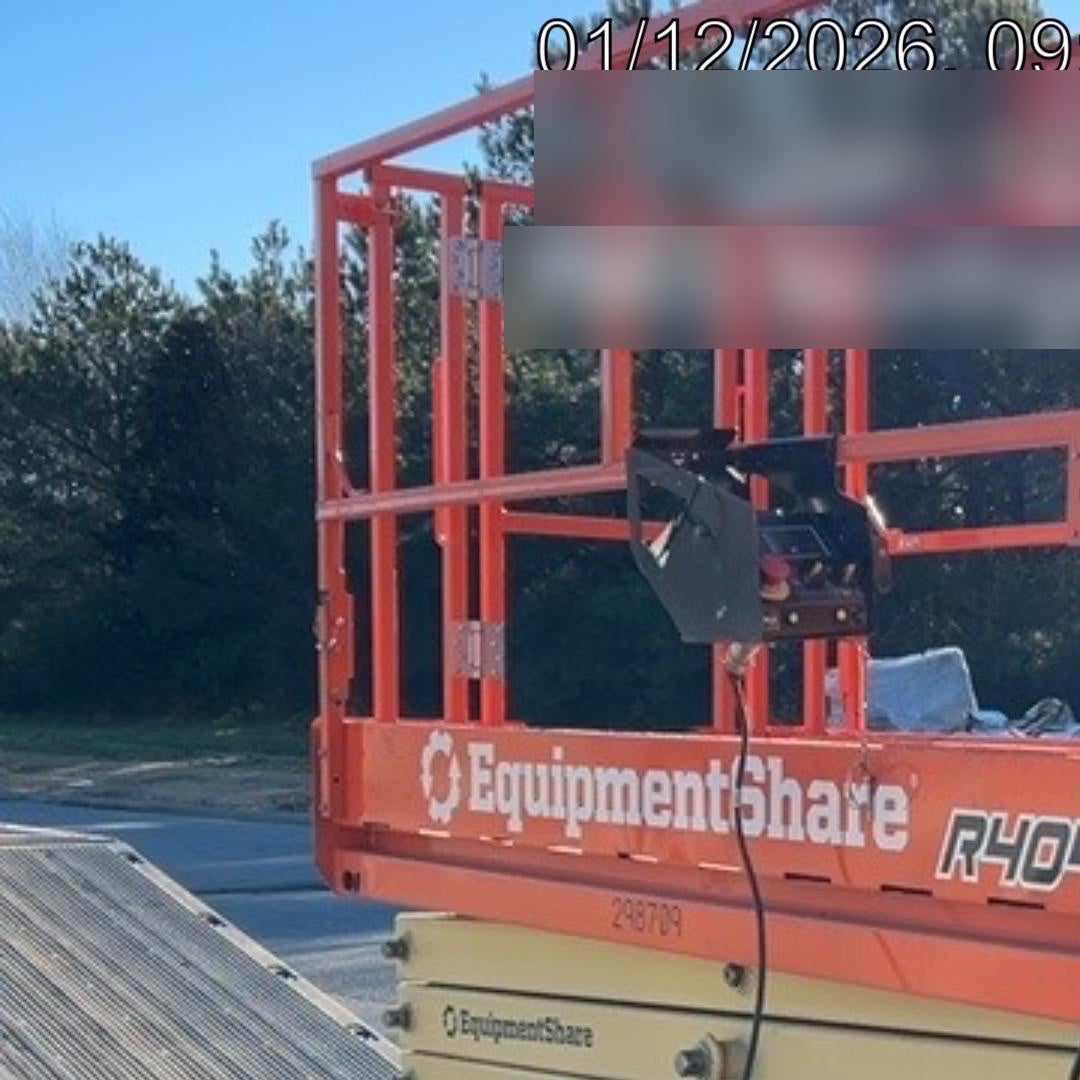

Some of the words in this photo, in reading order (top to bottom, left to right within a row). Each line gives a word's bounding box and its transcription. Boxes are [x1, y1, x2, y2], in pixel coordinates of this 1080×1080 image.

[468, 742, 910, 850] EquipmentShare
[611, 895, 682, 936] 298709
[460, 1009, 594, 1048] EquipmentShare
